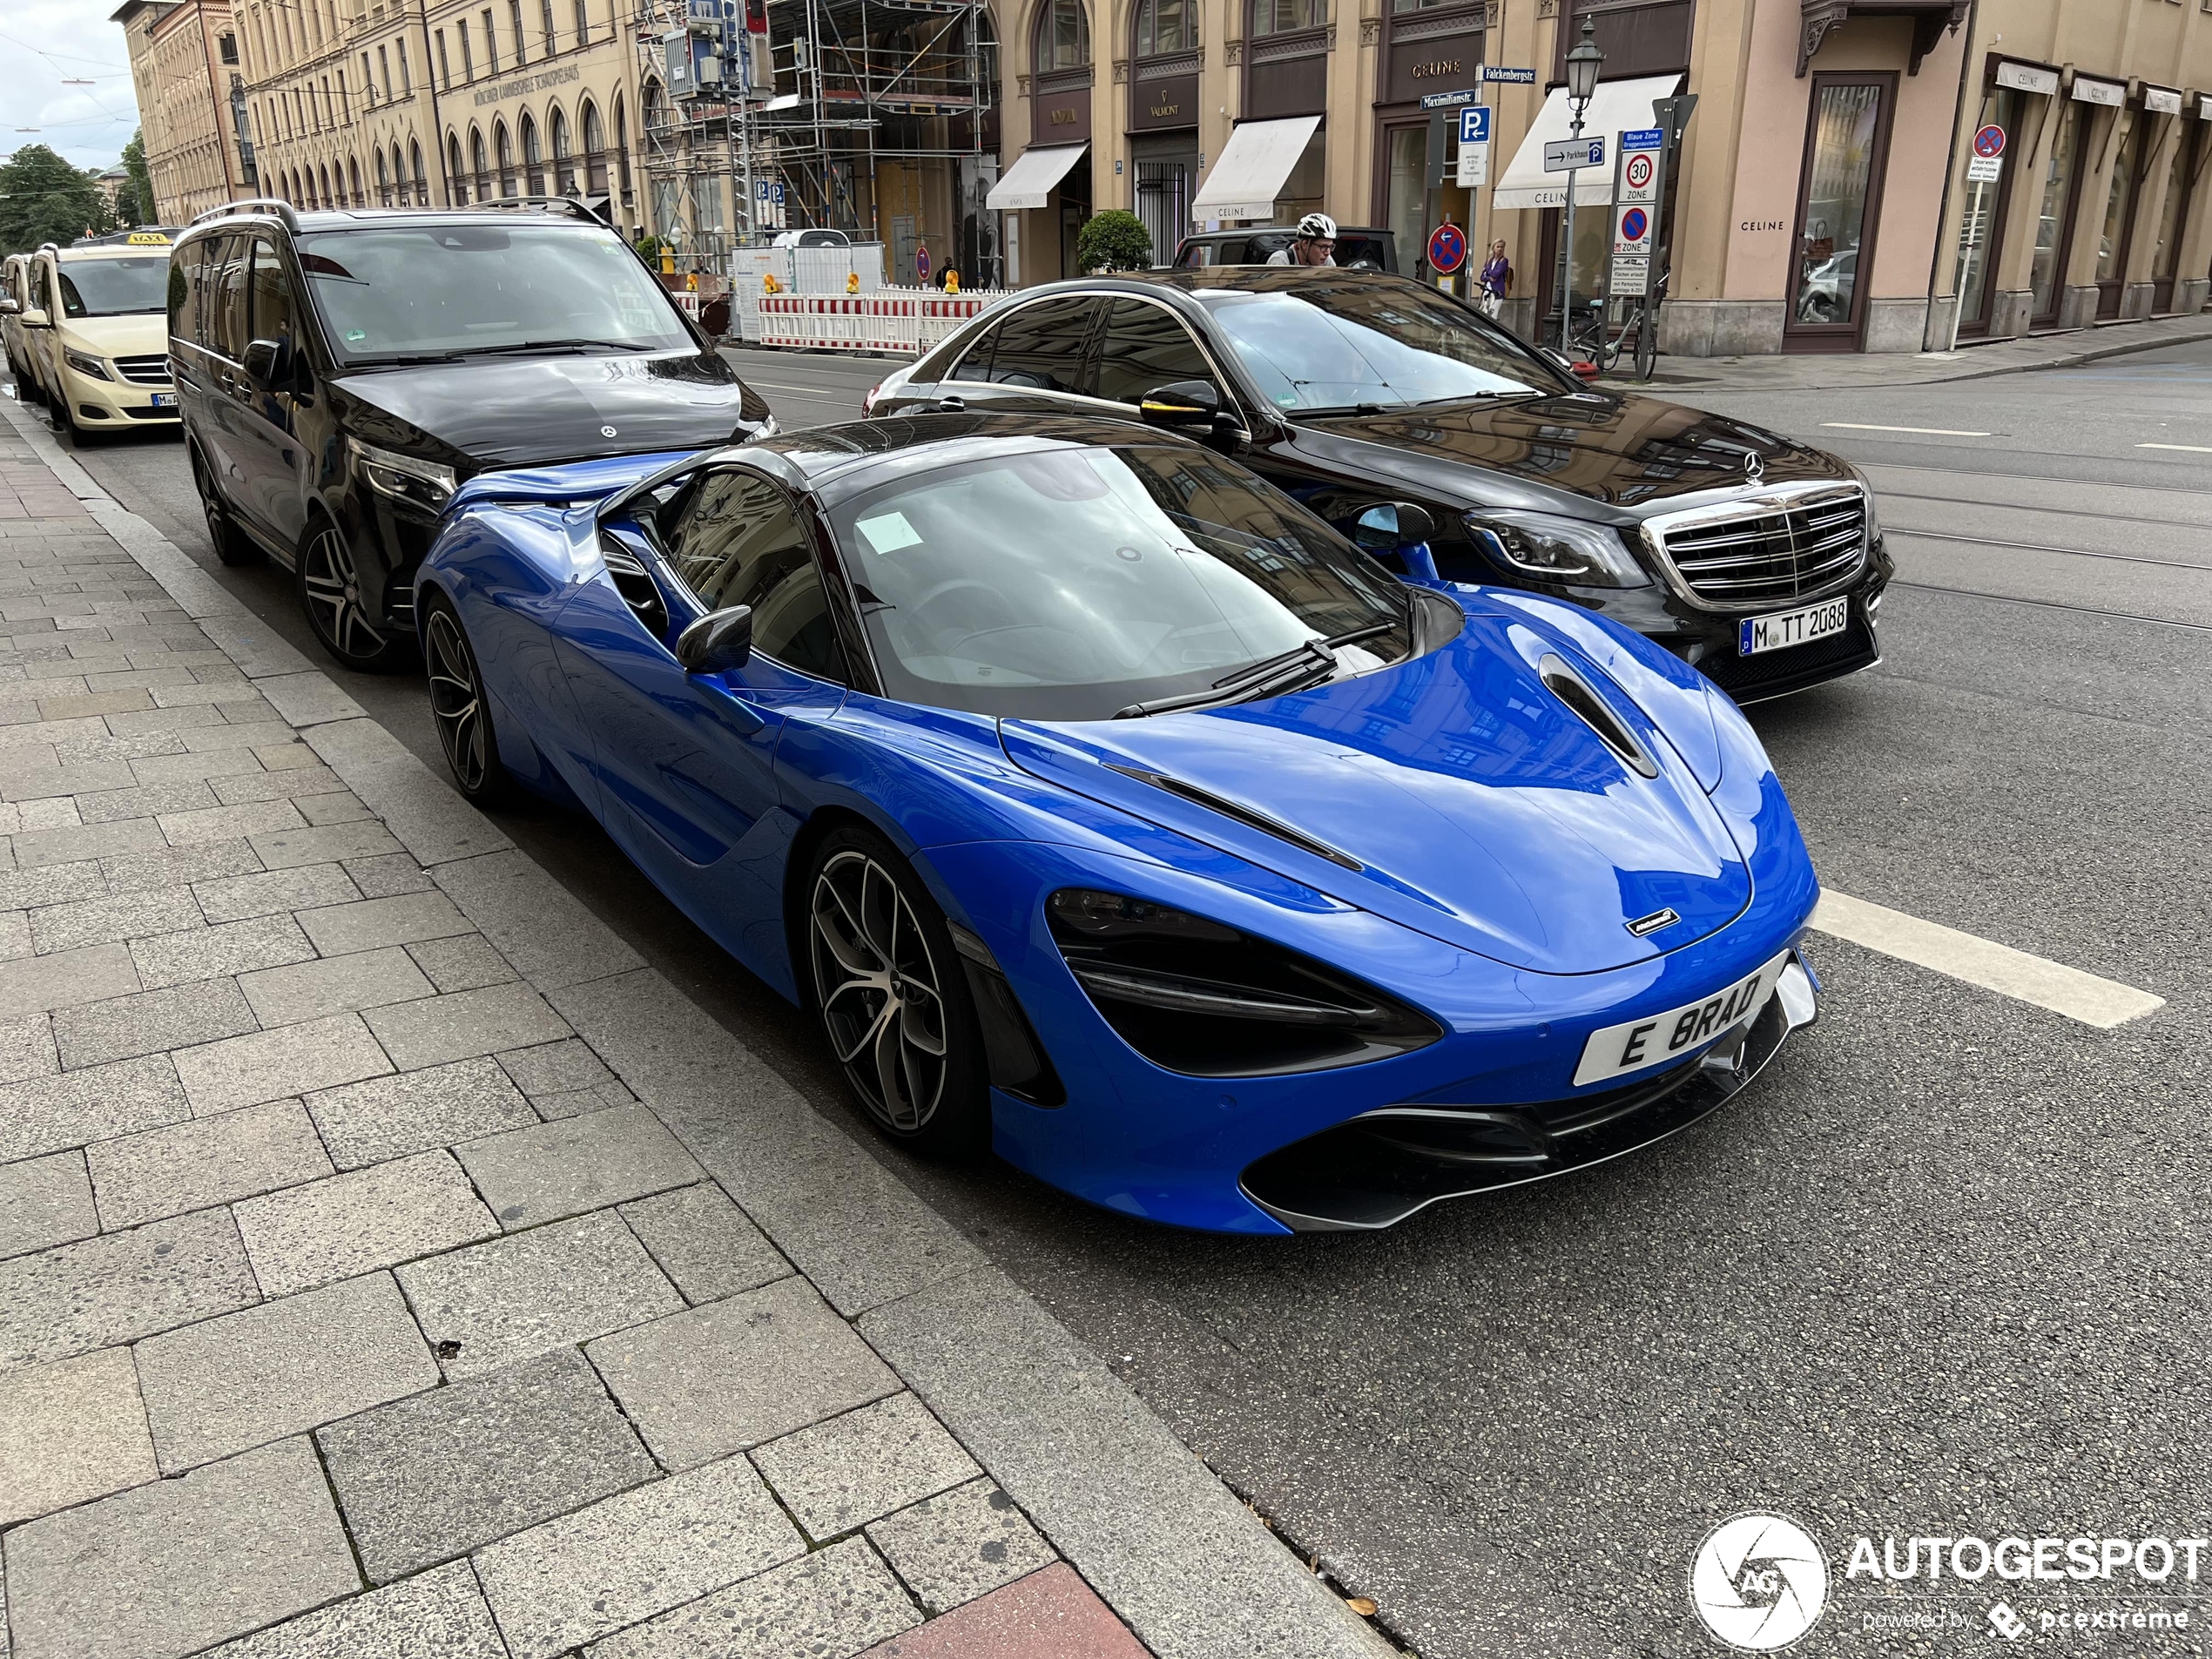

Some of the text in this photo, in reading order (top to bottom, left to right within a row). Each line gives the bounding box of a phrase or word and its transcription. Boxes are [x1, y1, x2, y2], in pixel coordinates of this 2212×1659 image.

[1412, 60, 1460, 78] CELINE
[1486, 68, 1534, 83] Falckenbergstr.
[2018, 73, 2039, 87] CELINE
[1424, 92, 1472, 108] Maximilianstr.
[1150, 105, 1179, 117] VALMONT
[1464, 111, 1481, 139] P
[1567, 150, 1588, 160] Parkhaus
[1631, 163, 1648, 179] 30
[1534, 192, 1568, 204] CELIN
[1627, 190, 1648, 199] ZONE
[1218, 207, 1244, 217] CELINE
[1741, 220, 1784, 231] CELINE
[1622, 243, 1642, 252] ZONE
[158, 395, 166, 405] M
[1754, 621, 1767, 649] M
[1782, 613, 1805, 643] TT
[1809, 602, 1845, 637] 2088
[1619, 1022, 1657, 1068] E
